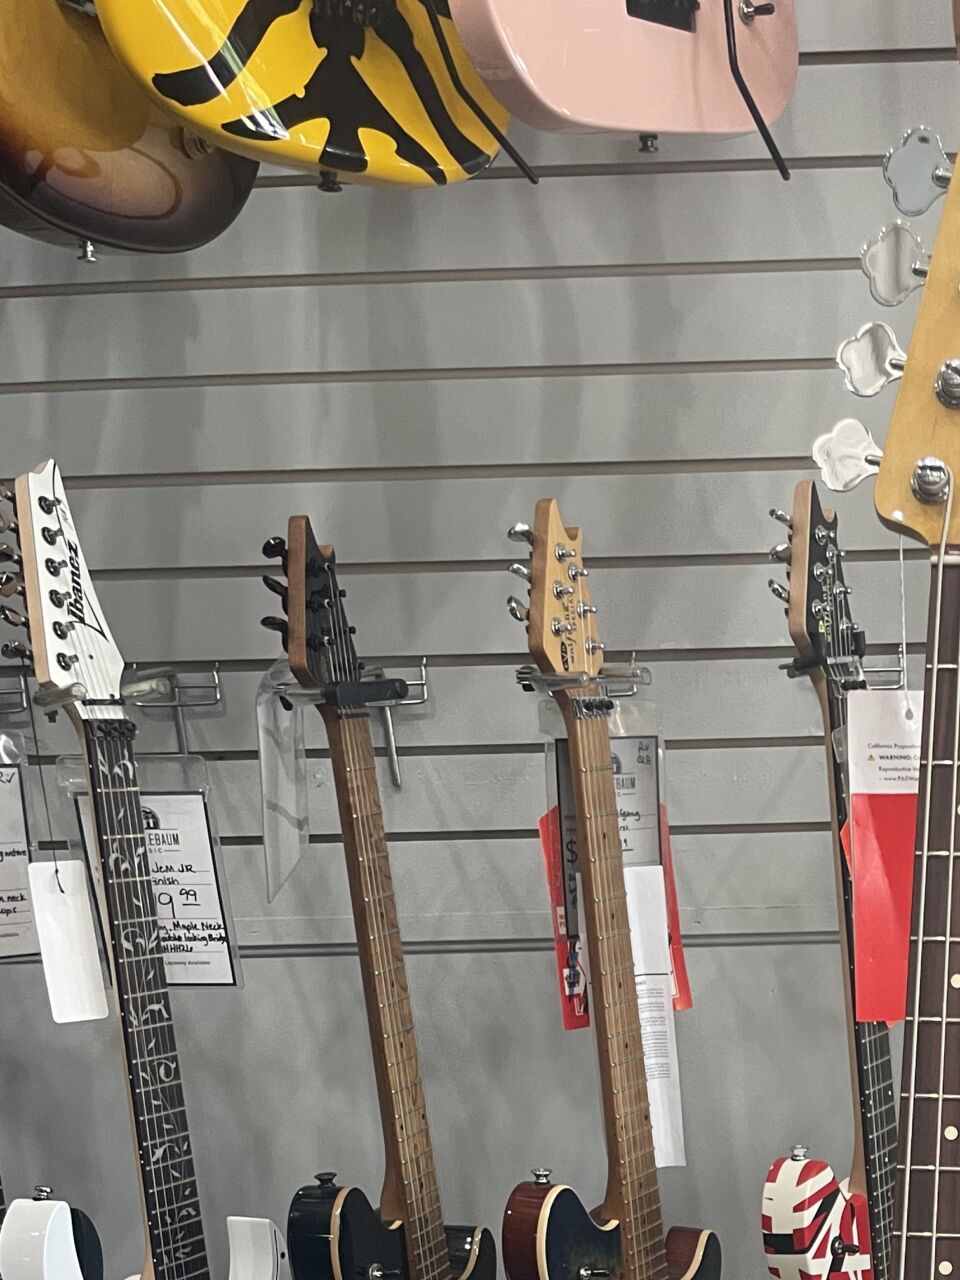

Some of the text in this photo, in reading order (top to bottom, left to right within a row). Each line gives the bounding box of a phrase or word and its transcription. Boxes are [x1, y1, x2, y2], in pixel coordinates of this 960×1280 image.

[66, 540, 87, 625] Ibanez
[616, 777, 636, 789] BAUM
[148, 833, 180, 846] EBAUM
[152, 876, 179, 885] inish
